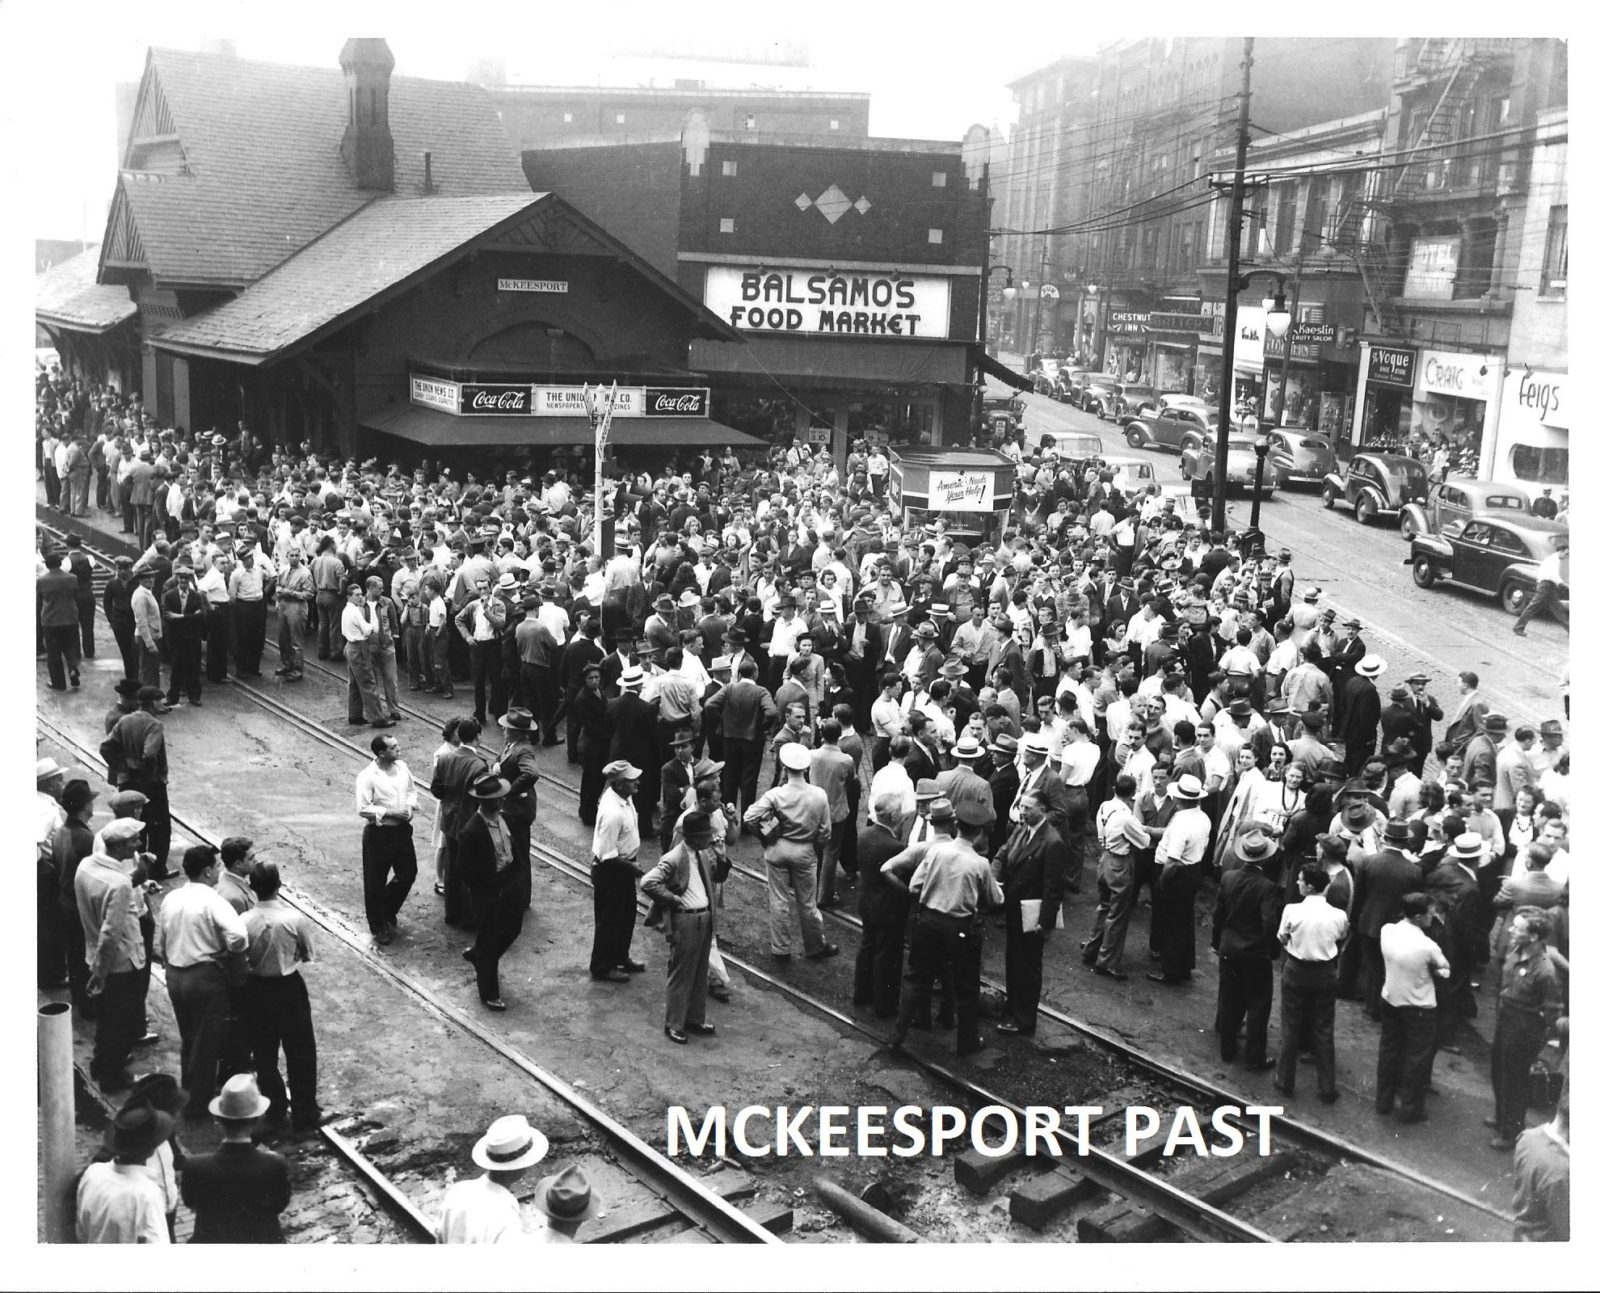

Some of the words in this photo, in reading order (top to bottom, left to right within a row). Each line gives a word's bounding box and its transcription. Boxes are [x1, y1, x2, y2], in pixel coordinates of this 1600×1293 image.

[741, 272, 915, 309] BALSAMOS
[730, 306, 803, 330] FOOD
[818, 310, 921, 336] MARKET
[1112, 313, 1151, 321] CHESTNUT
[1124, 323, 1138, 332] INN
[1299, 324, 1334, 336] Kaeslin
[1379, 350, 1409, 373] Vogue
[472, 390, 526, 410] Coca-Cola
[546, 392, 563, 402] THE
[565, 392, 585, 402] UNIO
[654, 393, 701, 412] Coca-Cola
